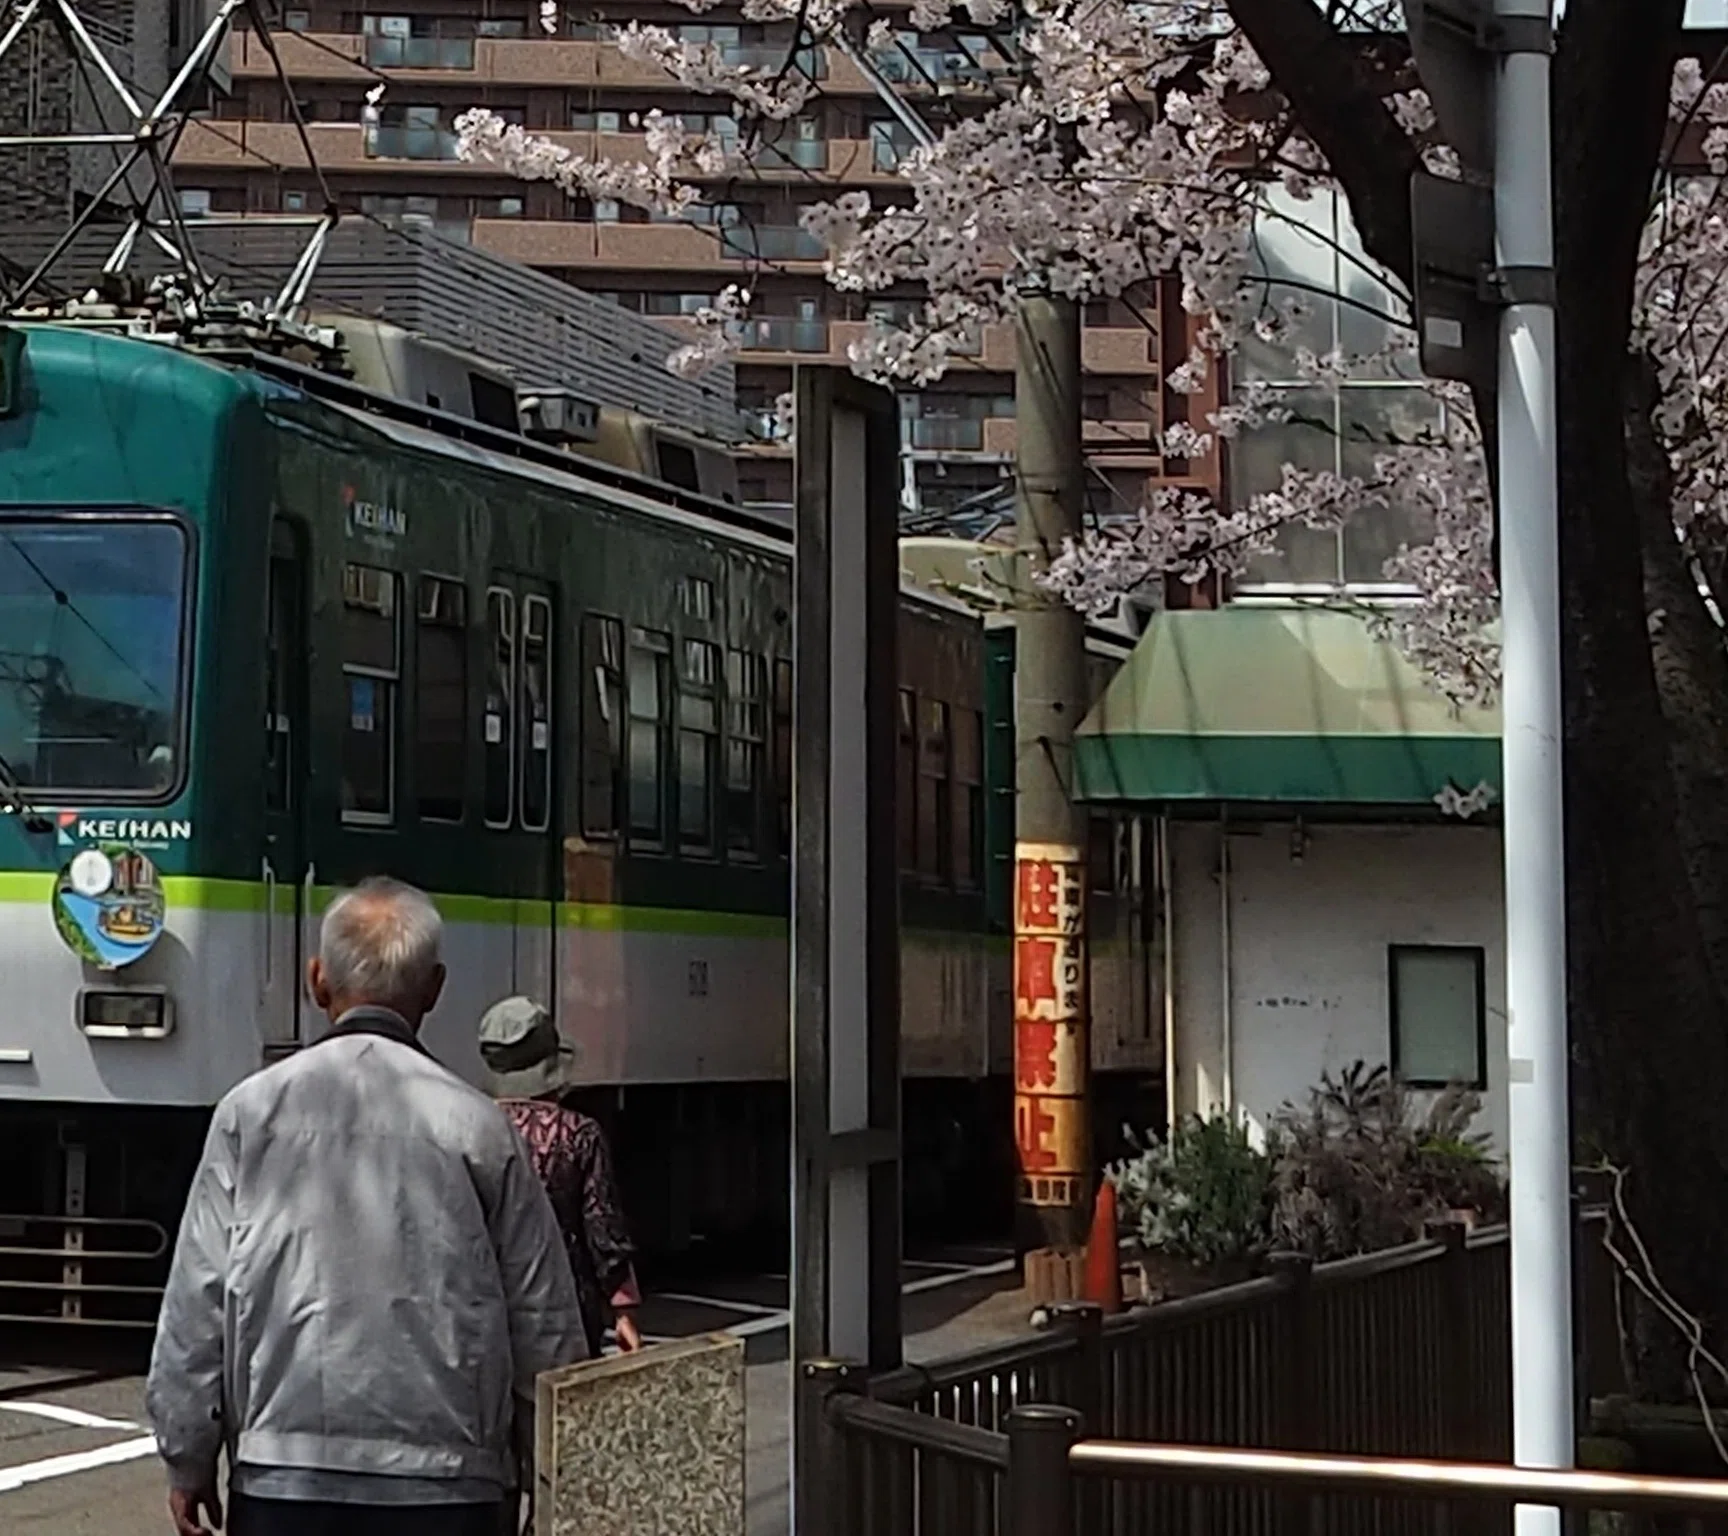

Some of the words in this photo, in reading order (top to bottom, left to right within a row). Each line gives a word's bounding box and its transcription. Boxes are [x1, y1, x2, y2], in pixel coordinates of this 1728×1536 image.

[78, 819, 191, 839] KEIHAN
[1018, 858, 1059, 1169] 駐車禁止
